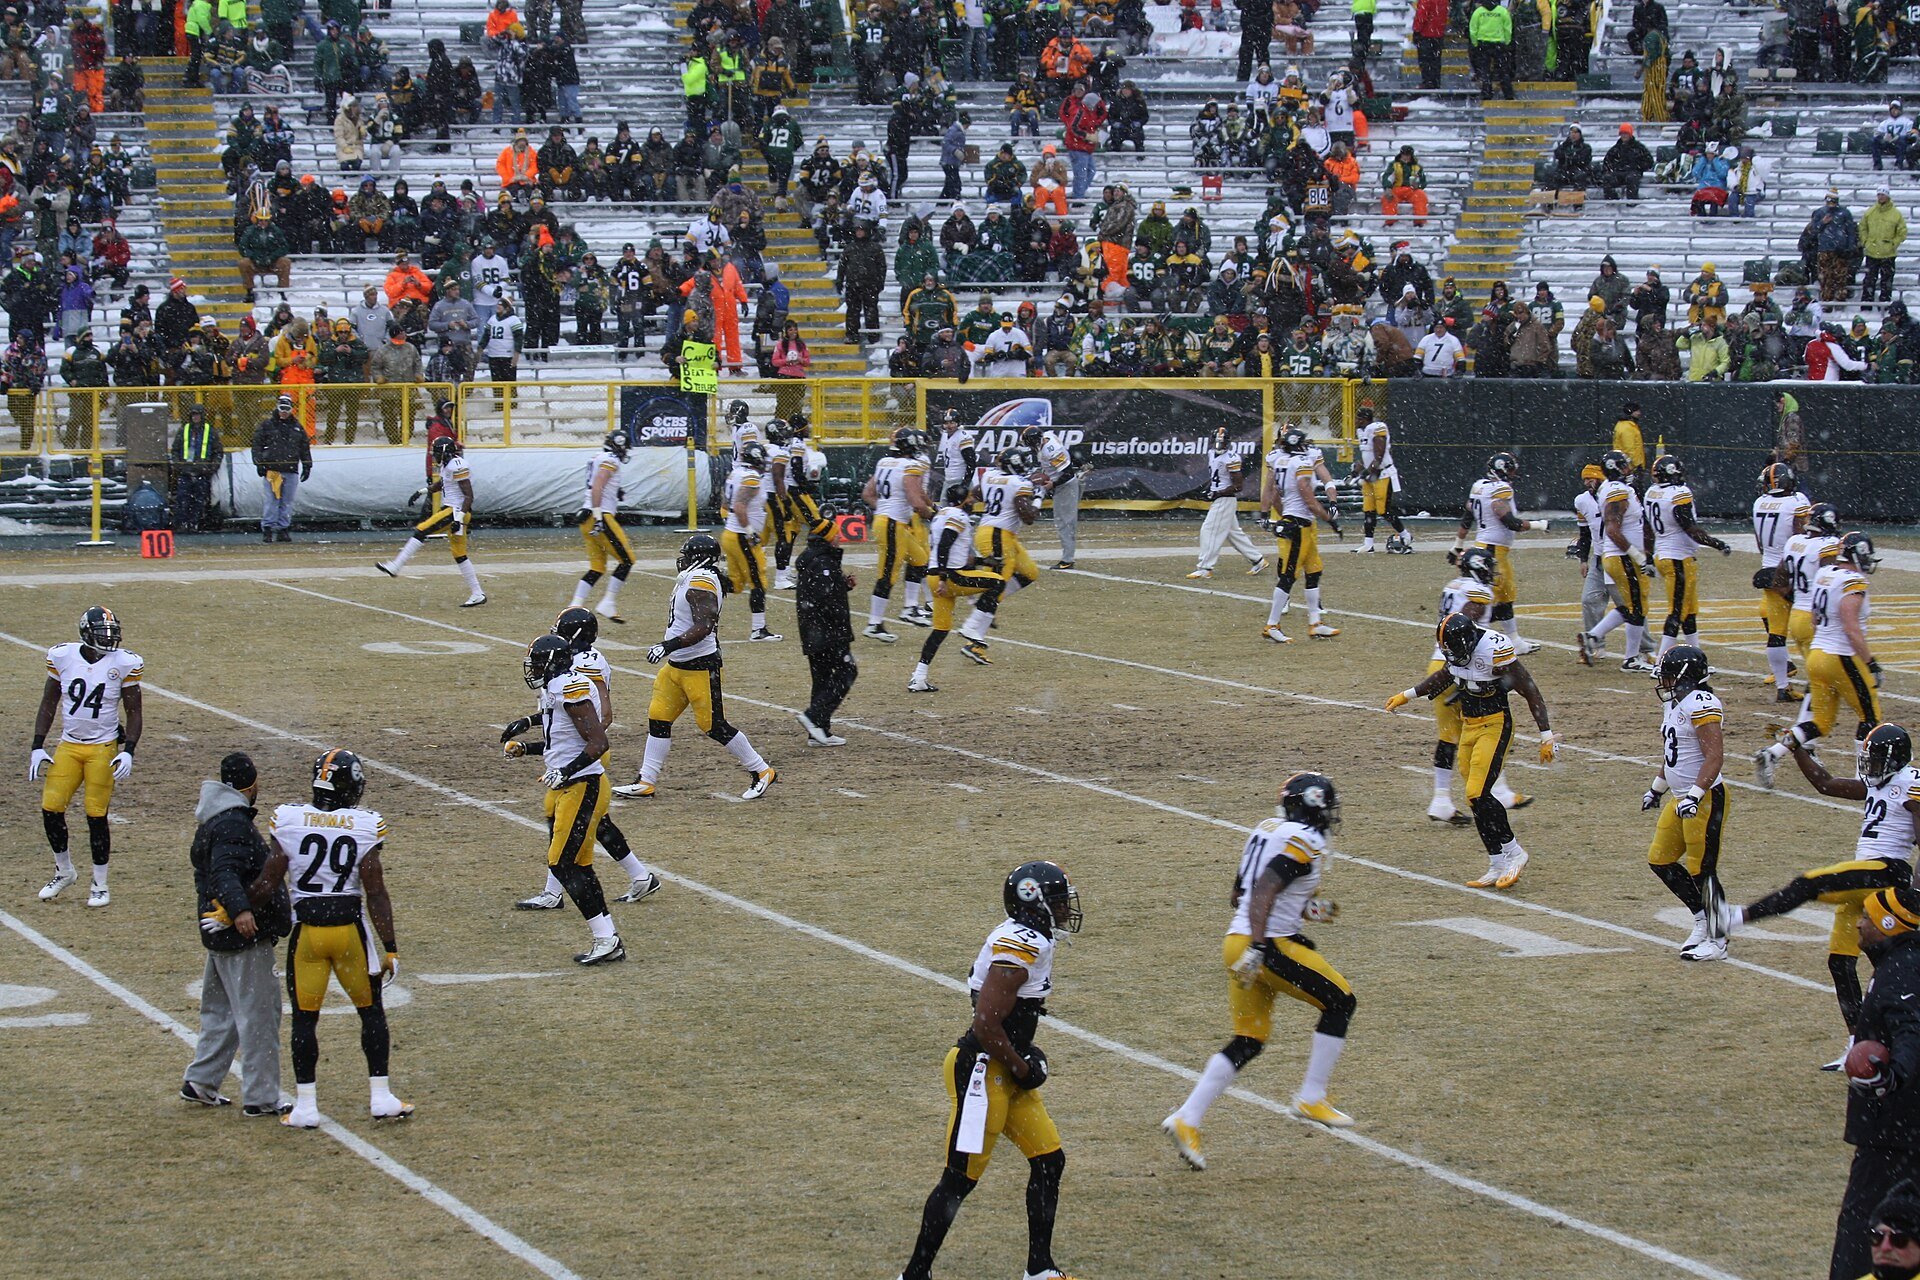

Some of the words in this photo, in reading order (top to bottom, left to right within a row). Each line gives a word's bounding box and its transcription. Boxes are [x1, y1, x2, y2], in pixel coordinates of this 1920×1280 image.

[866, 28, 882, 43] 12
[42, 53, 62, 71] 30
[41, 97, 57, 114] 52
[1335, 101, 1343, 116] 6
[769, 129, 789, 148] 12
[619, 149, 629, 164] 7
[1309, 189, 1328, 205] 84
[482, 268, 500, 284] 66
[1133, 263, 1154, 280] 66
[491, 326, 504, 339] 12
[1432, 343, 1444, 362] 7
[1289, 355, 1311, 375] 52
[683, 377, 717, 392] STEELERS
[663, 416, 688, 427] CBS
[641, 427, 688, 441] SPORTS
[841, 517, 864, 540] G
[1756, 512, 1780, 547] 77
[146, 533, 170, 557] 10
[68, 678, 106, 719] 94
[304, 812, 354, 830] THOMAS
[297, 833, 357, 893] 29
